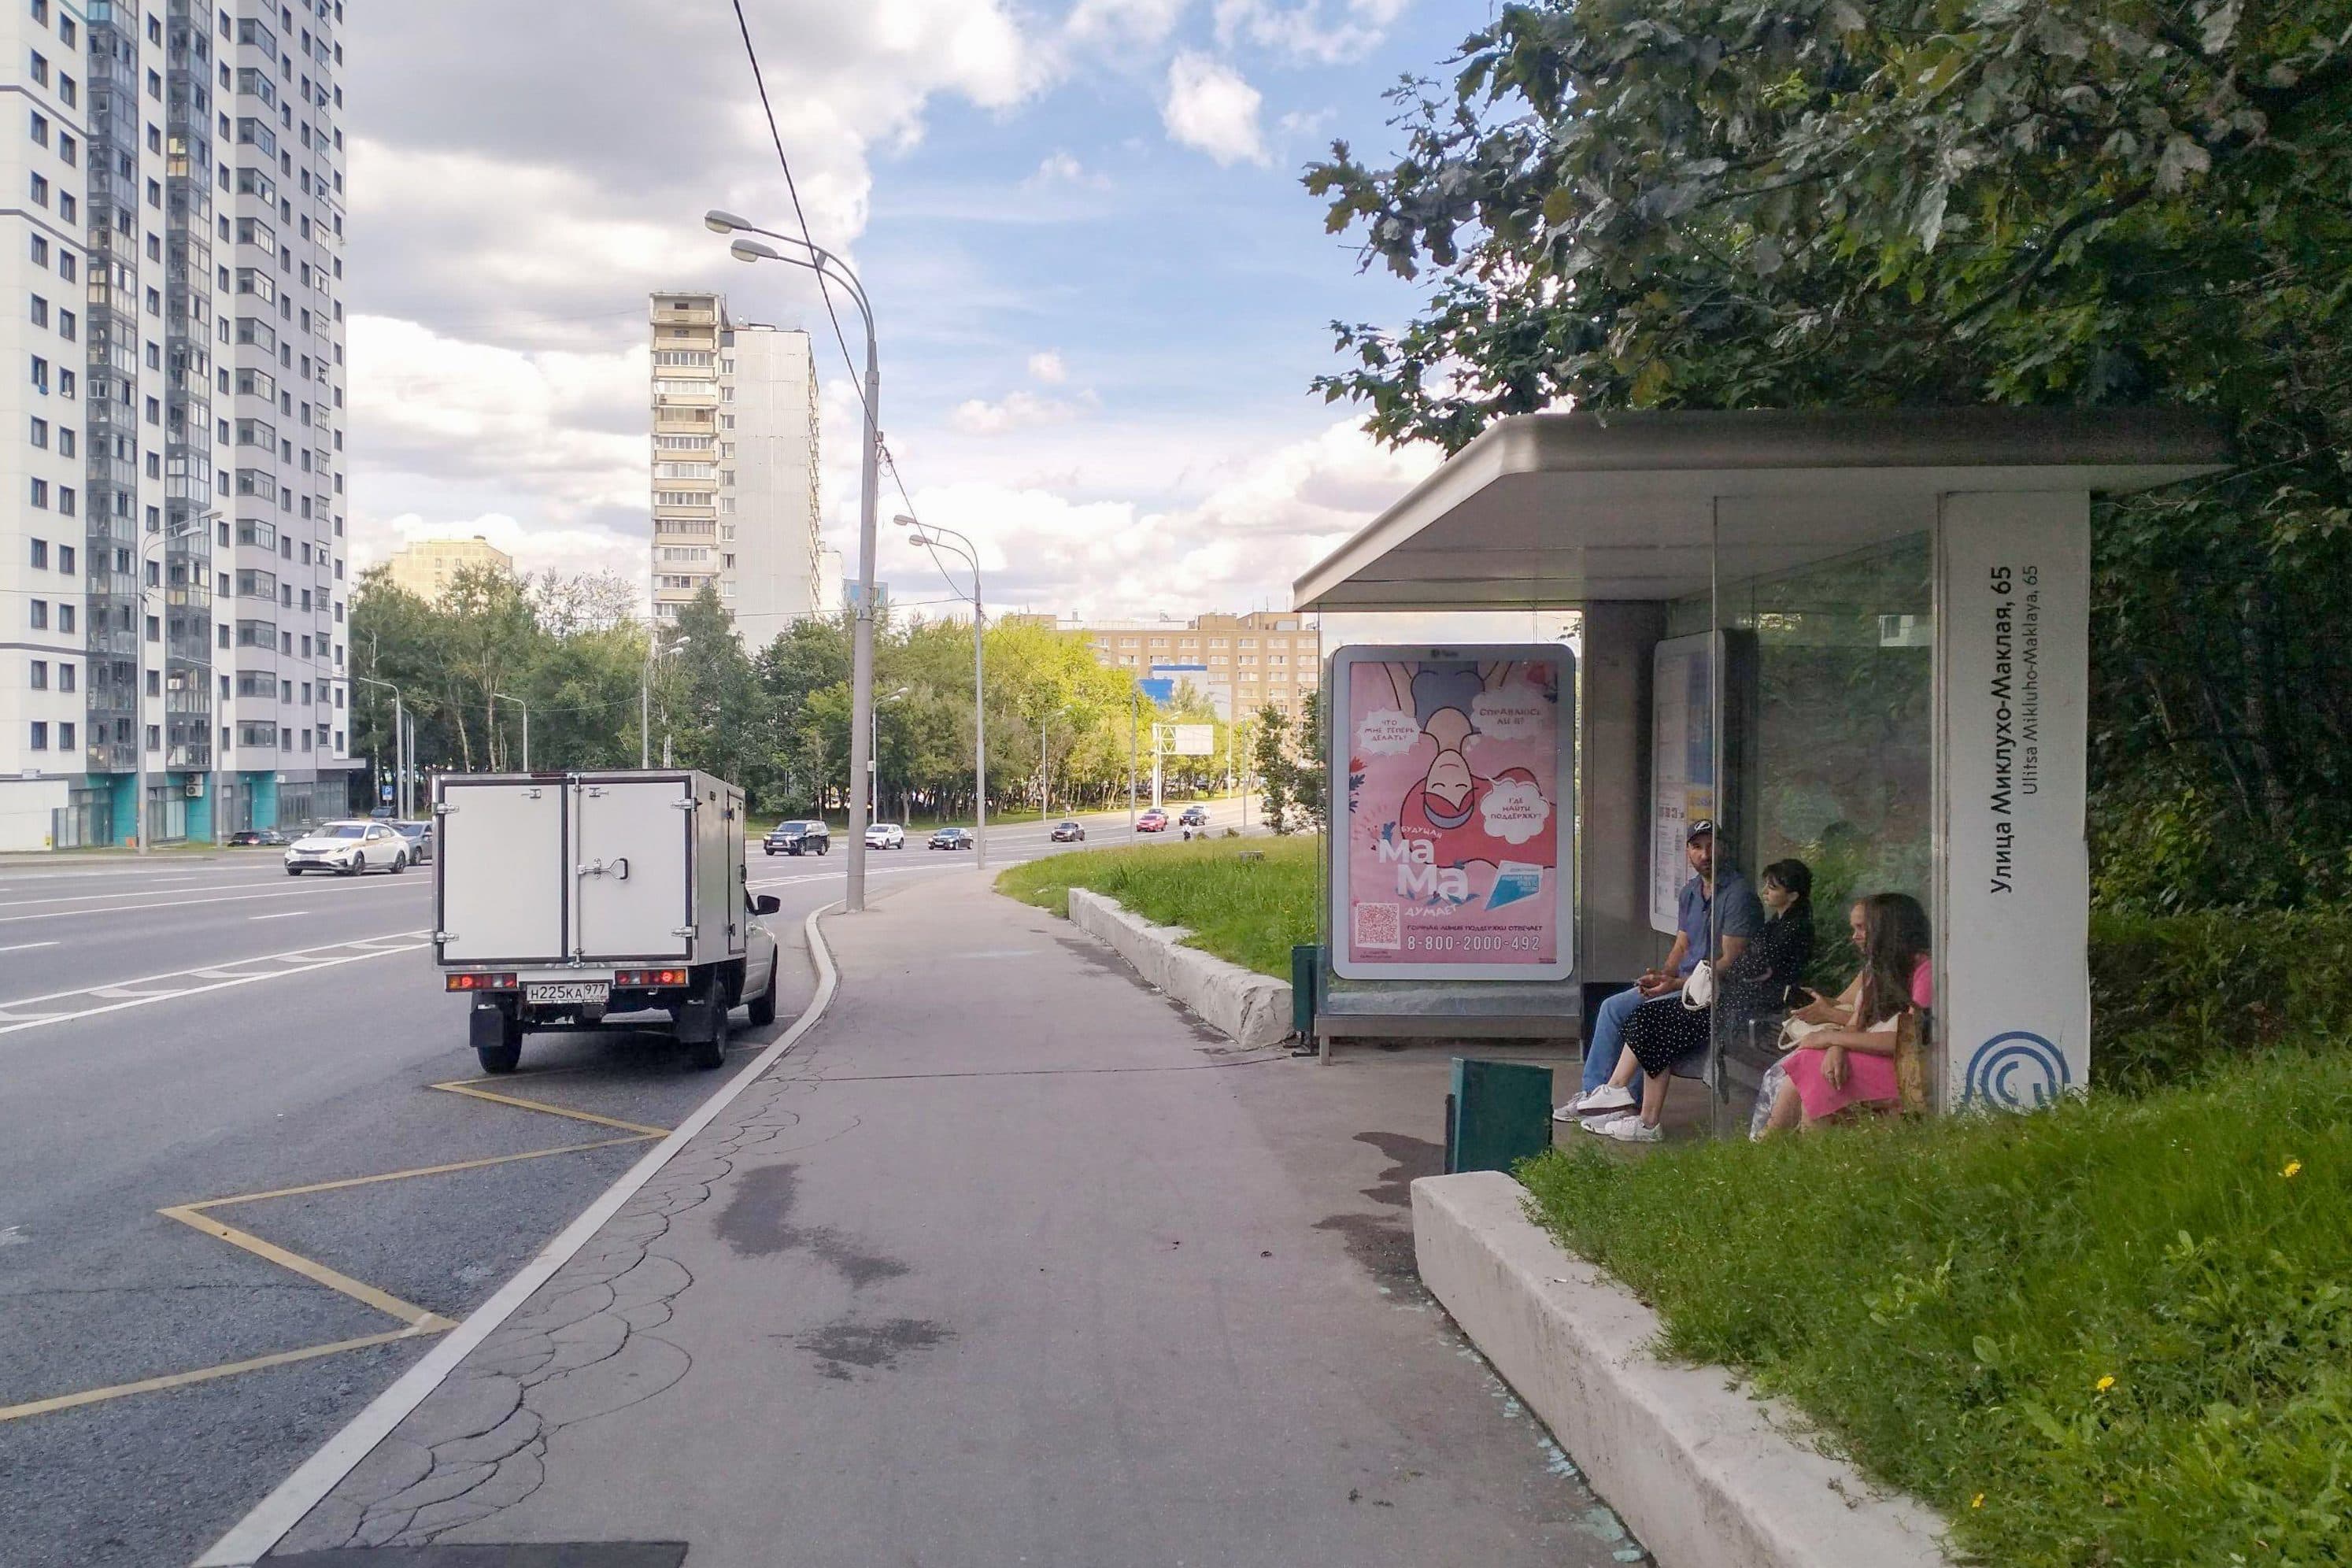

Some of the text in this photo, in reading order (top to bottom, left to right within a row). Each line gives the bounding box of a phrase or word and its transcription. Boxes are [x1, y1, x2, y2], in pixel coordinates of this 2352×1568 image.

[2021, 565, 2041, 794] Ulitsa Mikluho-Maklaya, 65
[1990, 566, 2017, 893] Улица Миклухо-Маклая, 65
[1401, 825, 1443, 839] БУДУЩАЯ
[1404, 904, 1457, 917] ДУМАЕТ
[1407, 934, 1541, 952] 8-800-2000-492
[585, 984, 605, 994] 977
